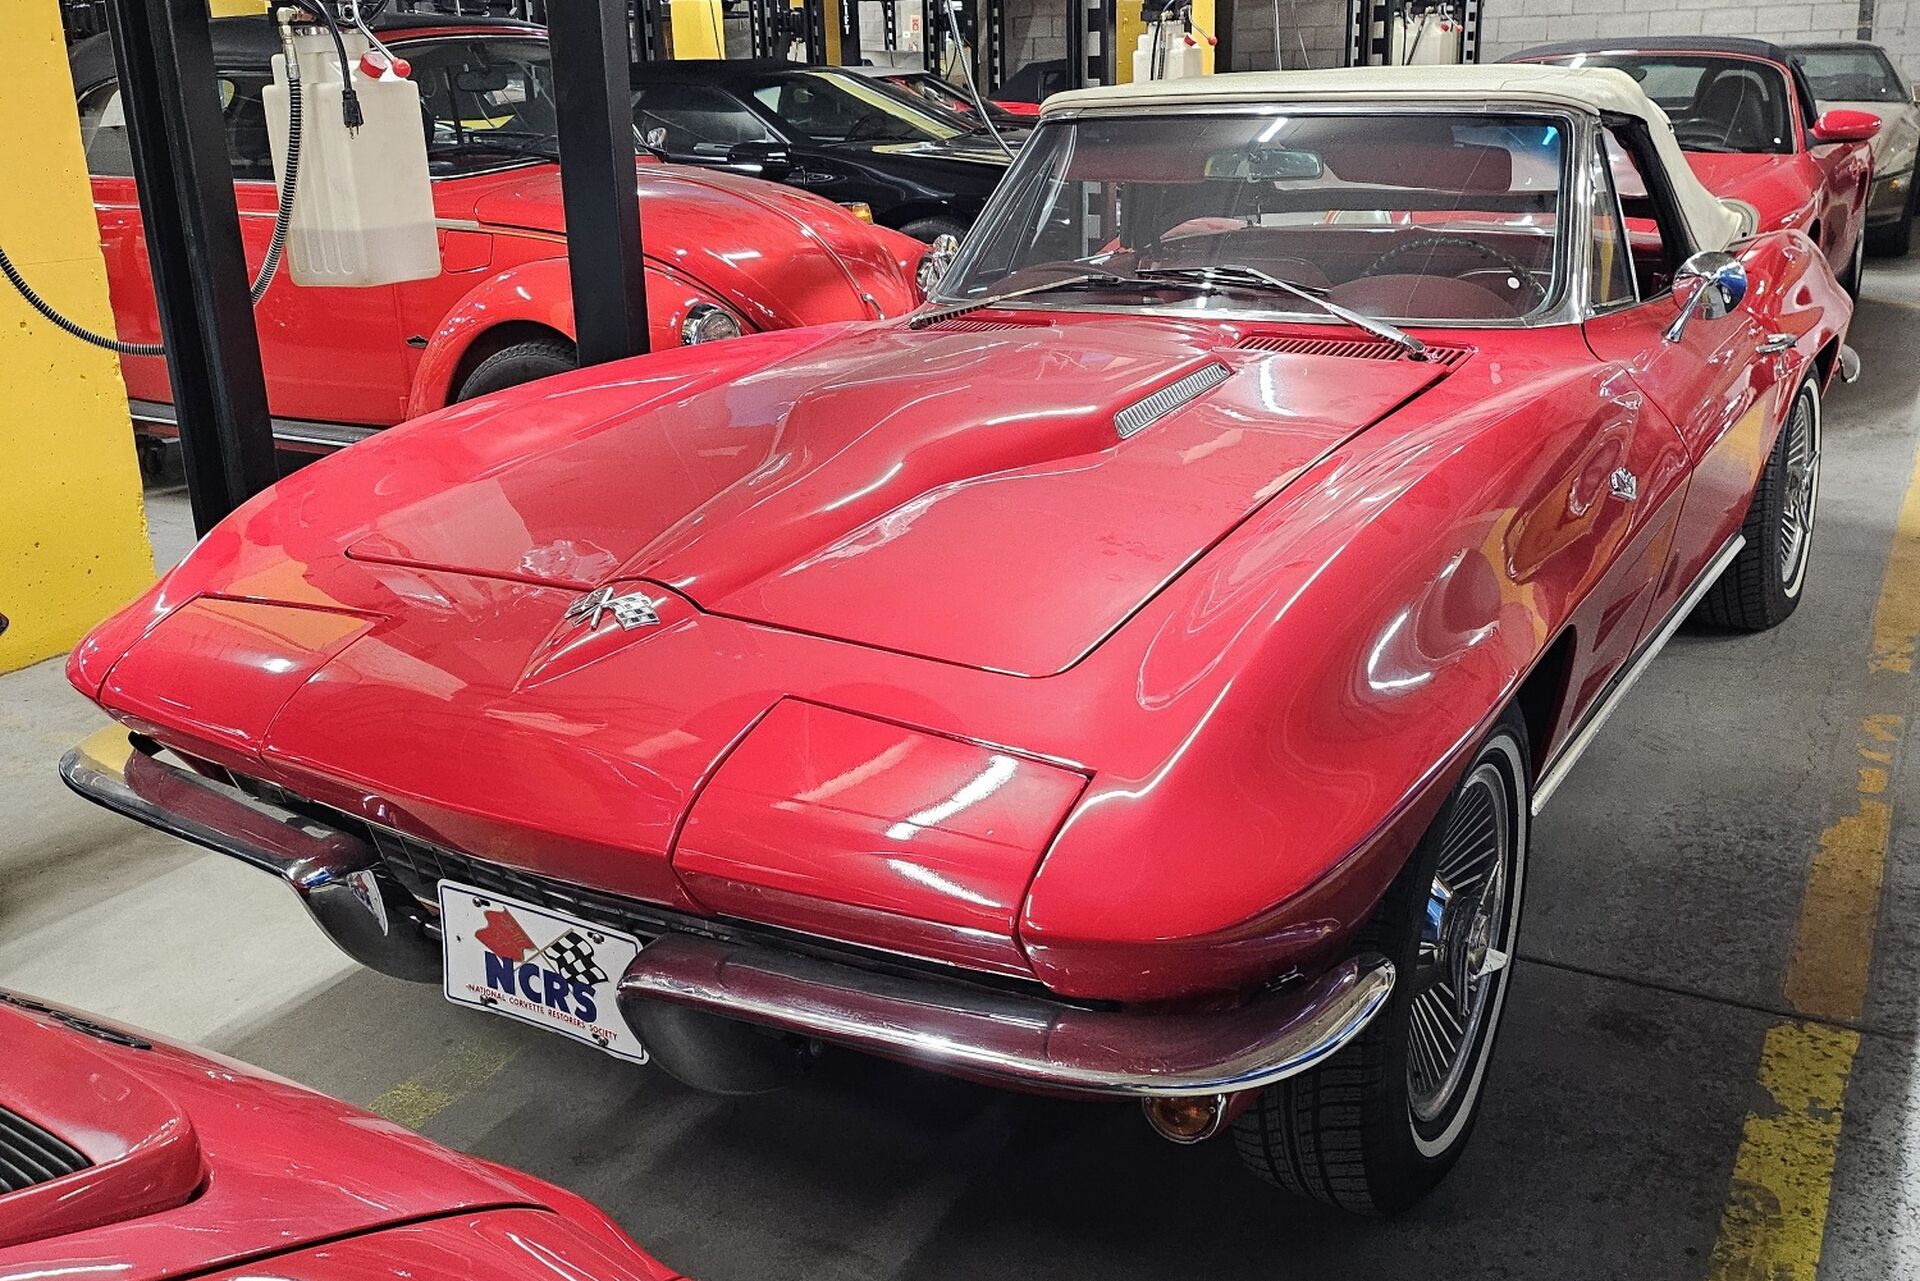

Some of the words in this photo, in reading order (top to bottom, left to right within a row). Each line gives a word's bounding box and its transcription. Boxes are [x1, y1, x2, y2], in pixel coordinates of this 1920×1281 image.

[484, 951, 597, 1023] NCRS
[509, 997, 545, 1014] CORVETTE
[548, 1008, 586, 1029] RESTORERS
[589, 1024, 618, 1041] SOCIETY
